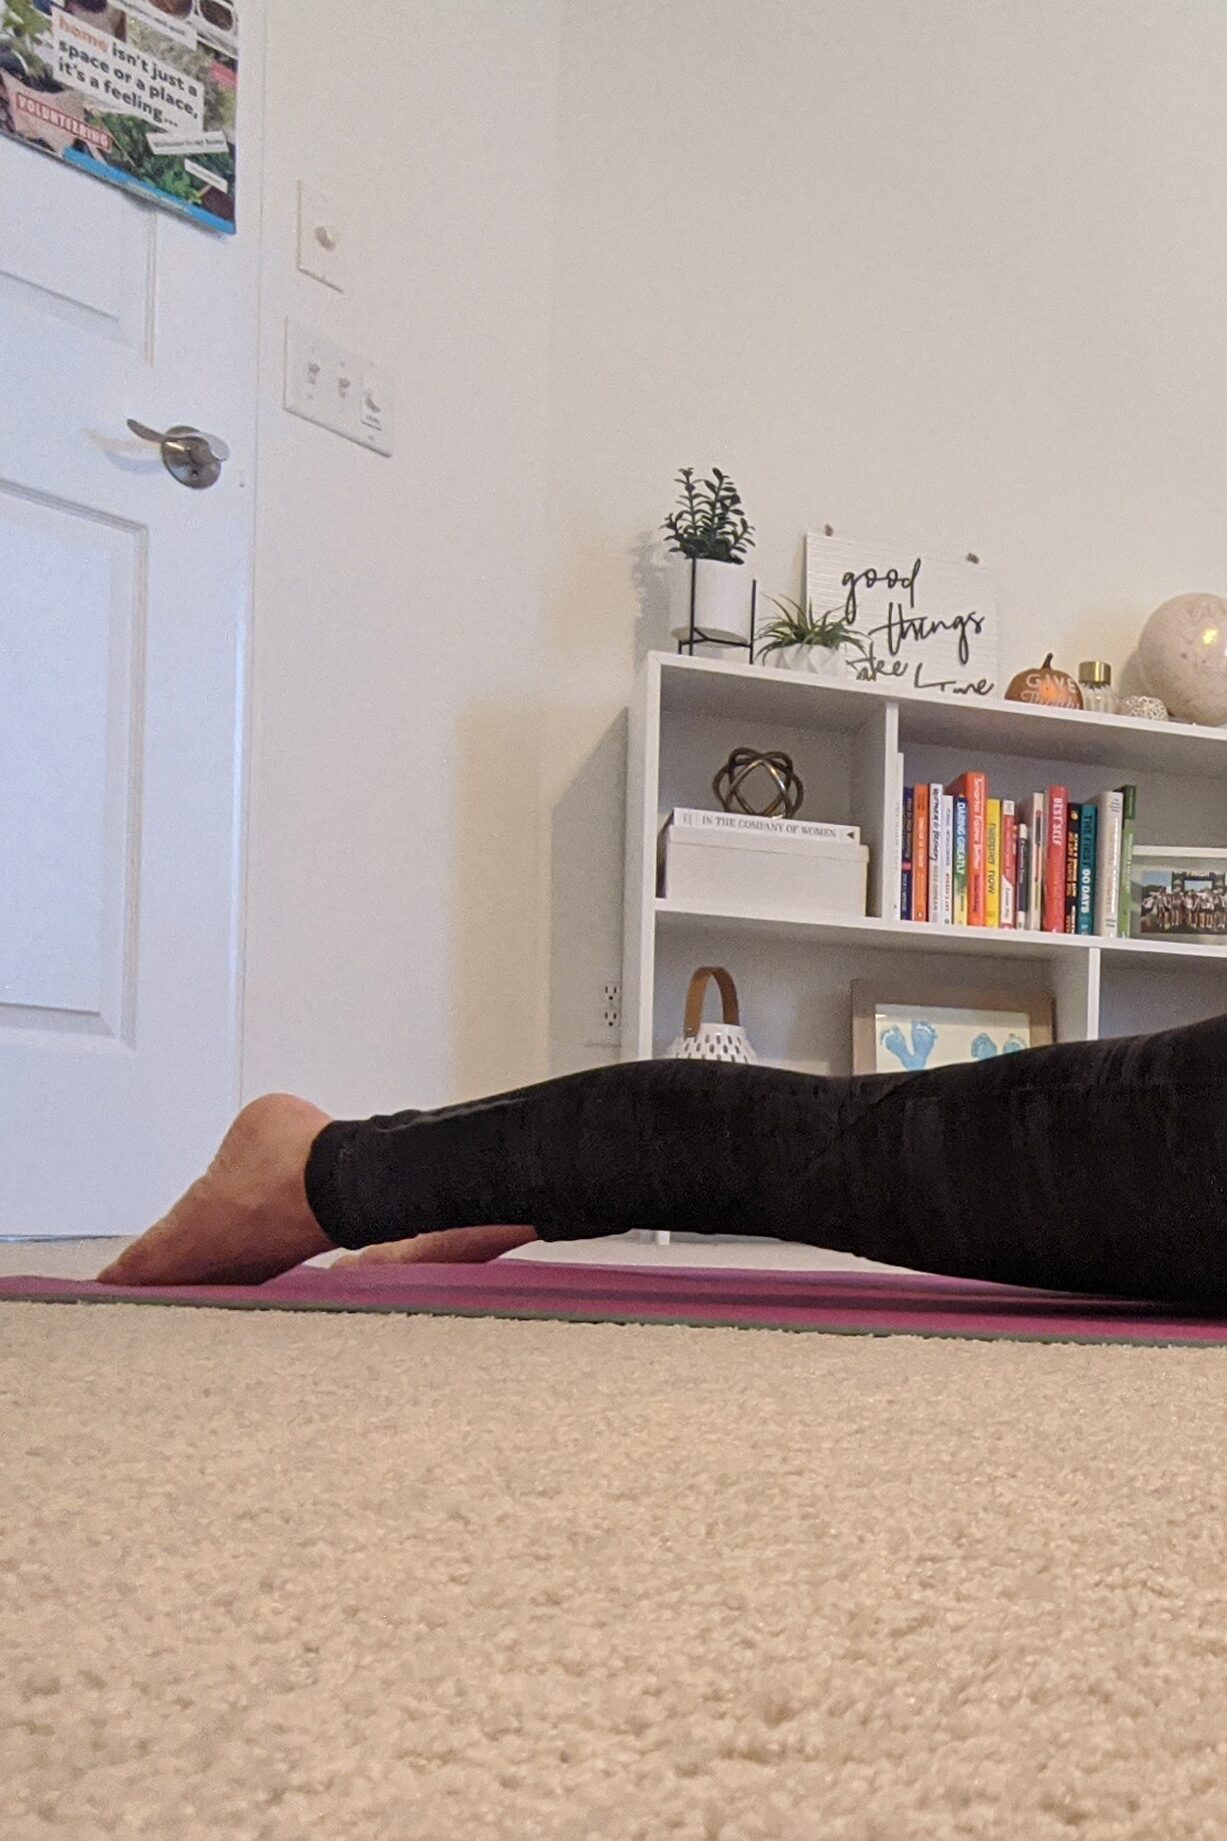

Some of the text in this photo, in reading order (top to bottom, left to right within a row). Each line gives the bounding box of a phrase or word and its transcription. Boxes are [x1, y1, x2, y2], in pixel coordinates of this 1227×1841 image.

[60, 15, 109, 52] home
[112, 42, 148, 73] isn't
[151, 62, 184, 90] just
[188, 85, 197, 97] a
[60, 40, 198, 119] space or a place,
[60, 57, 177, 127] it's a feeling...
[841, 558, 921, 625] good
[868, 602, 985, 664] things
[1026, 673, 1076, 693] GIVE
[702, 815, 711, 825] IN
[714, 816, 735, 828] THE
[738, 817, 783, 832] COMPANY
[786, 824, 798, 834] OF
[800, 826, 837, 837] WOMEN
[957, 802, 966, 835] DARING
[1052, 822, 1062, 846] SELF
[1053, 797, 1063, 820] BEST
[956, 836, 966, 874] GREATLY
[988, 823, 997, 894] happier now
[1081, 815, 1092, 913] THE FIRST 90 DAYS
